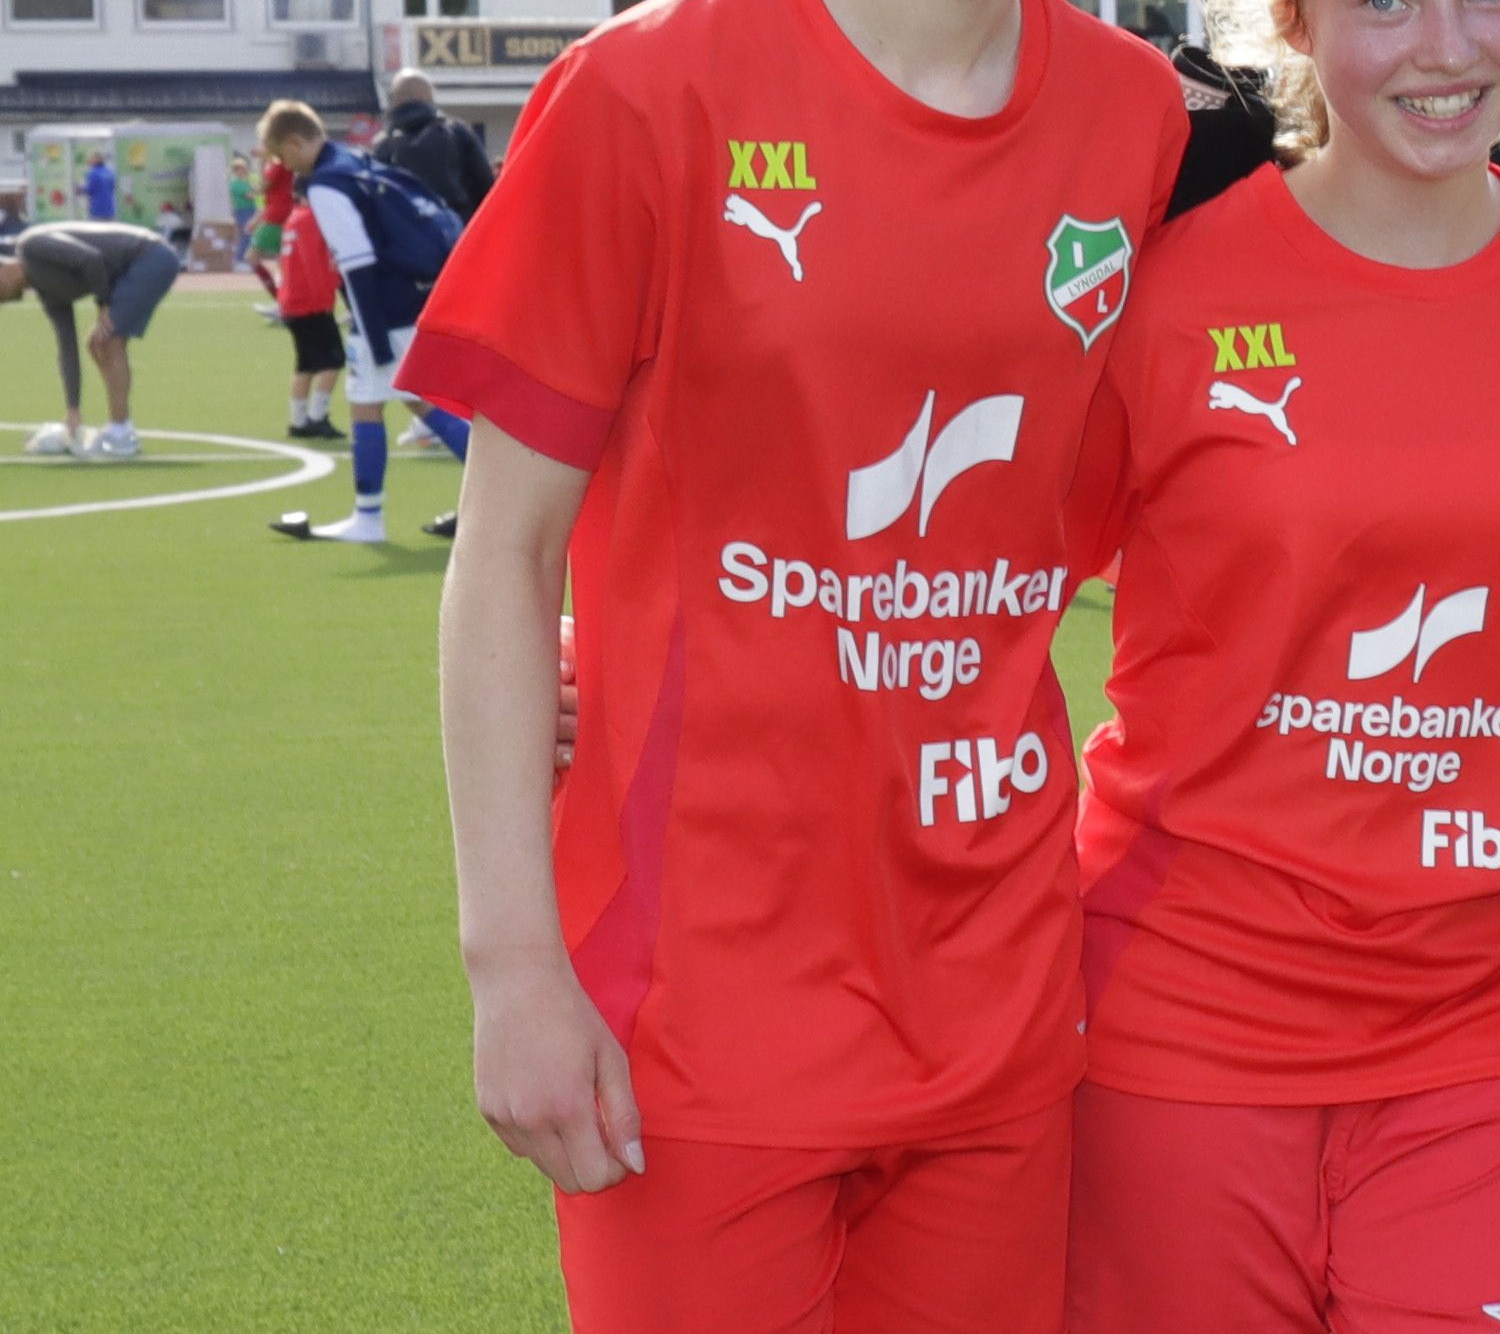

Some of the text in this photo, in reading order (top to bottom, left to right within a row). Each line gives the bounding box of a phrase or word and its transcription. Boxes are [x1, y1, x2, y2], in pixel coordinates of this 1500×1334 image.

[421, 28, 483, 66] XL
[728, 139, 817, 191] XXL
[1067, 260, 1117, 297] LYNGDAL
[1208, 322, 1296, 372] XXL
[837, 626, 982, 701] Norge
[919, 732, 1048, 828] Fibo
[1325, 737, 1461, 792] Norge
